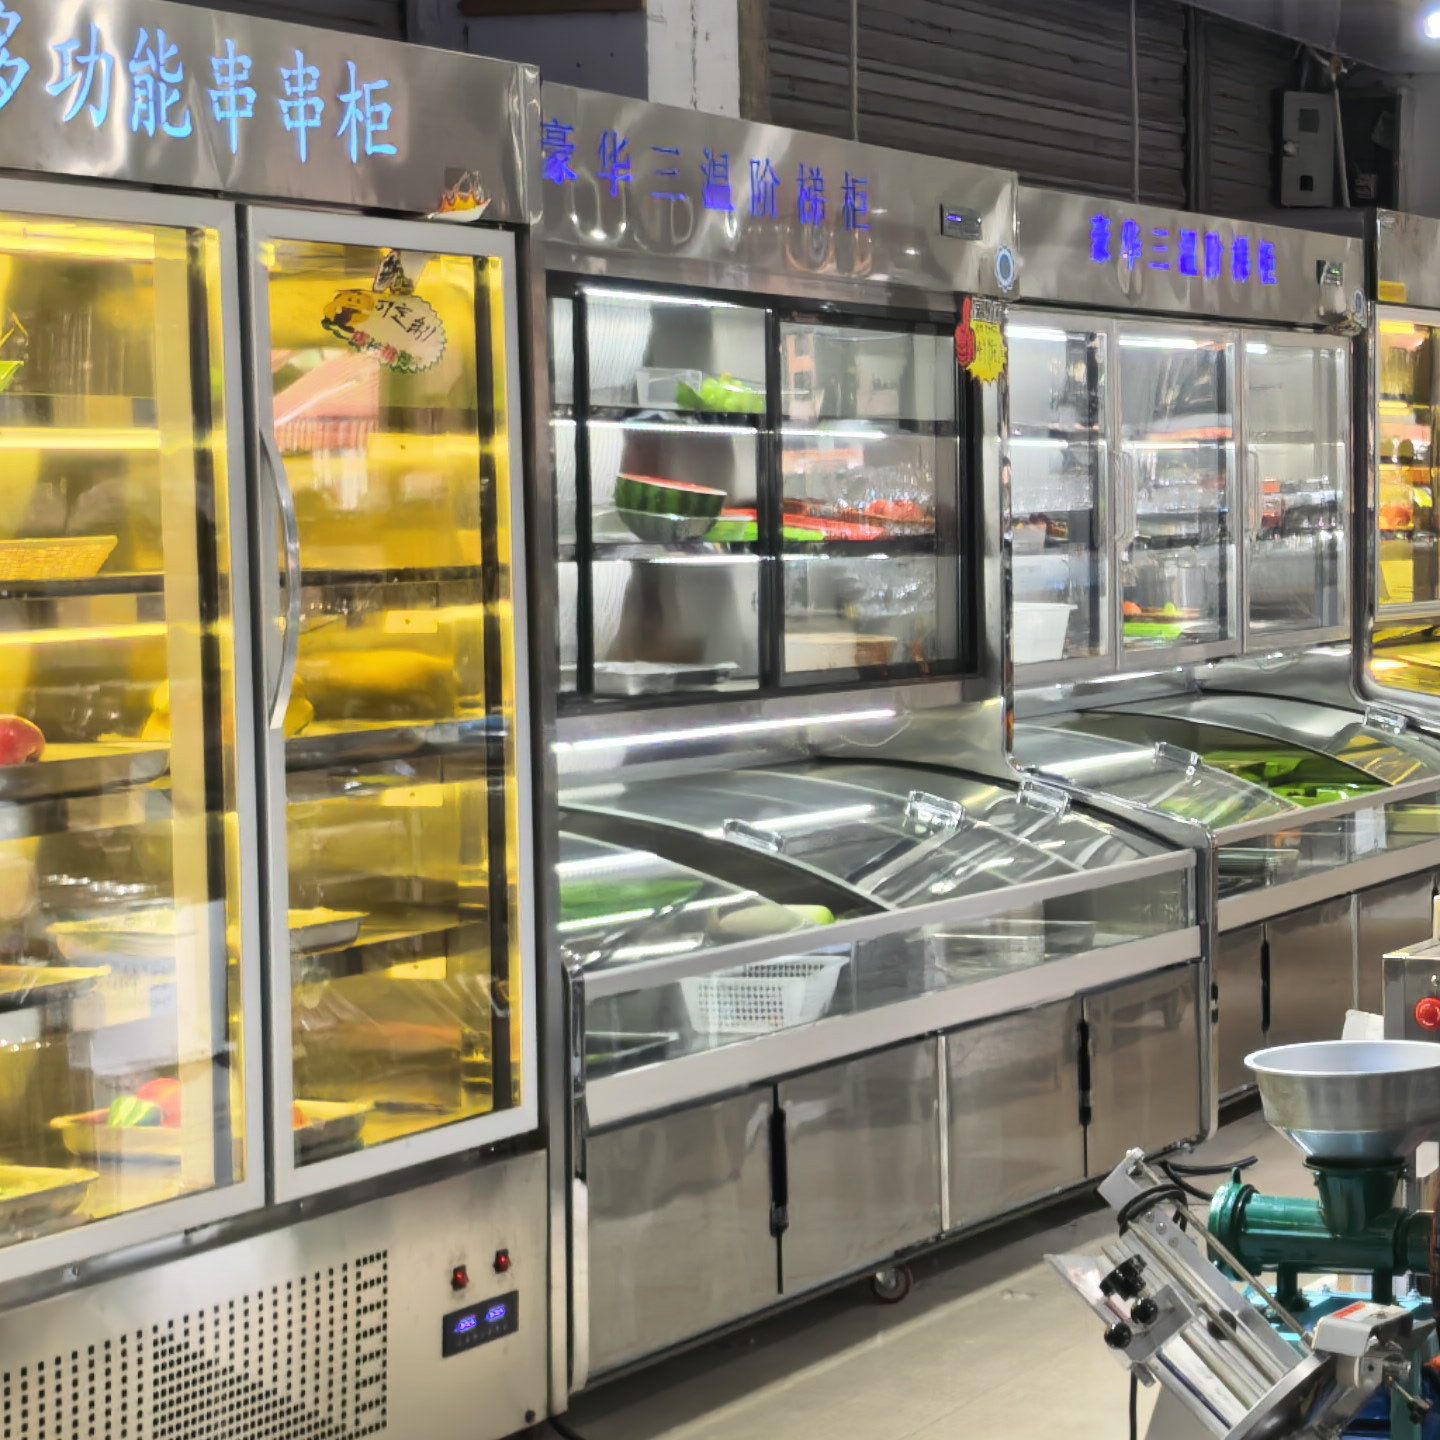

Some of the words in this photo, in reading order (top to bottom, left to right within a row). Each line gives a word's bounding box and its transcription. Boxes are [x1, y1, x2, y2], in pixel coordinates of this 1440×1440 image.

[540, 117, 870, 231] 豪华三温阶梯柜
